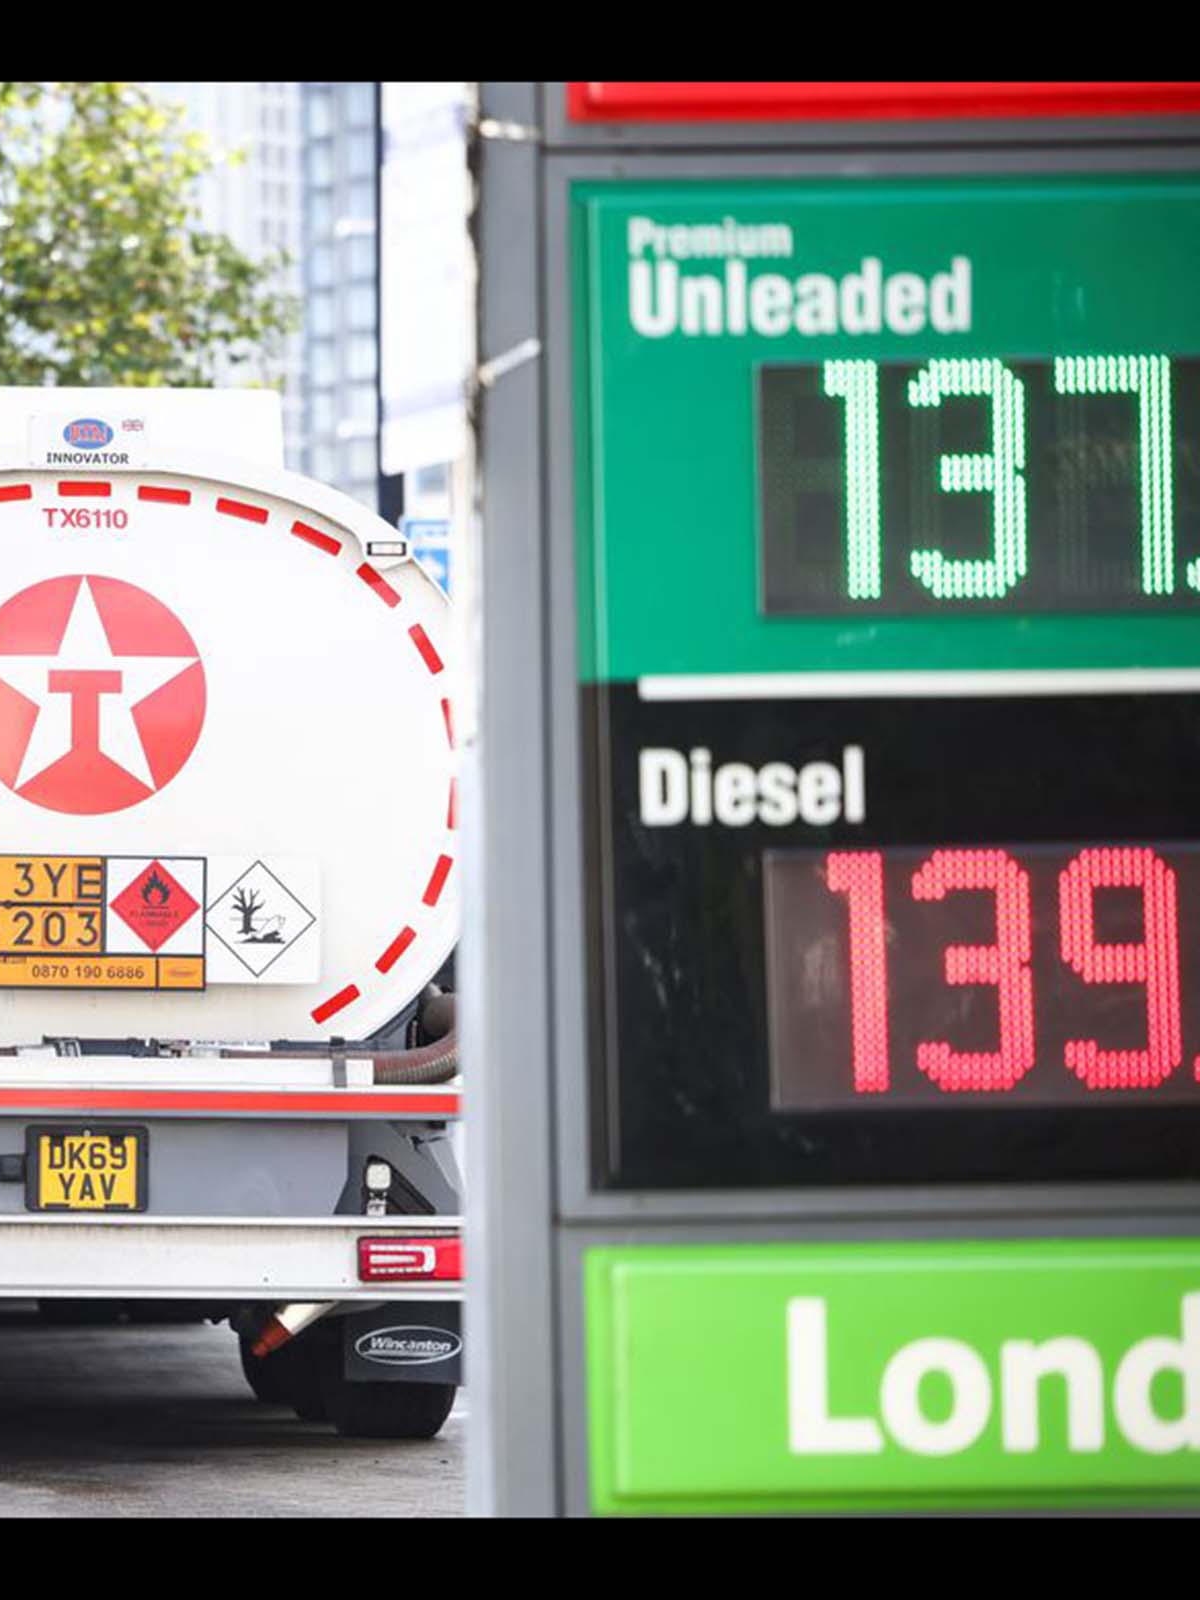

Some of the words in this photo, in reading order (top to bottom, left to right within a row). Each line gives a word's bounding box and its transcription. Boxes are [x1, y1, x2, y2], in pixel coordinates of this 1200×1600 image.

[627, 217, 793, 258] Premium
[627, 256, 972, 338] Unleaded
[46, 452, 129, 465] INNOVATOR
[42, 508, 128, 529] TX6110
[638, 745, 866, 827] Diesel
[13, 862, 102, 900] 3YE
[31, 964, 70, 979] 0870
[76, 964, 102, 979] 190
[106, 965, 145, 980] 6886
[49, 1141, 128, 1170] DK69
[58, 1173, 117, 1201] YAV
[371, 1336, 452, 1352] Wincanton
[786, 1291, 1200, 1456] Lond
